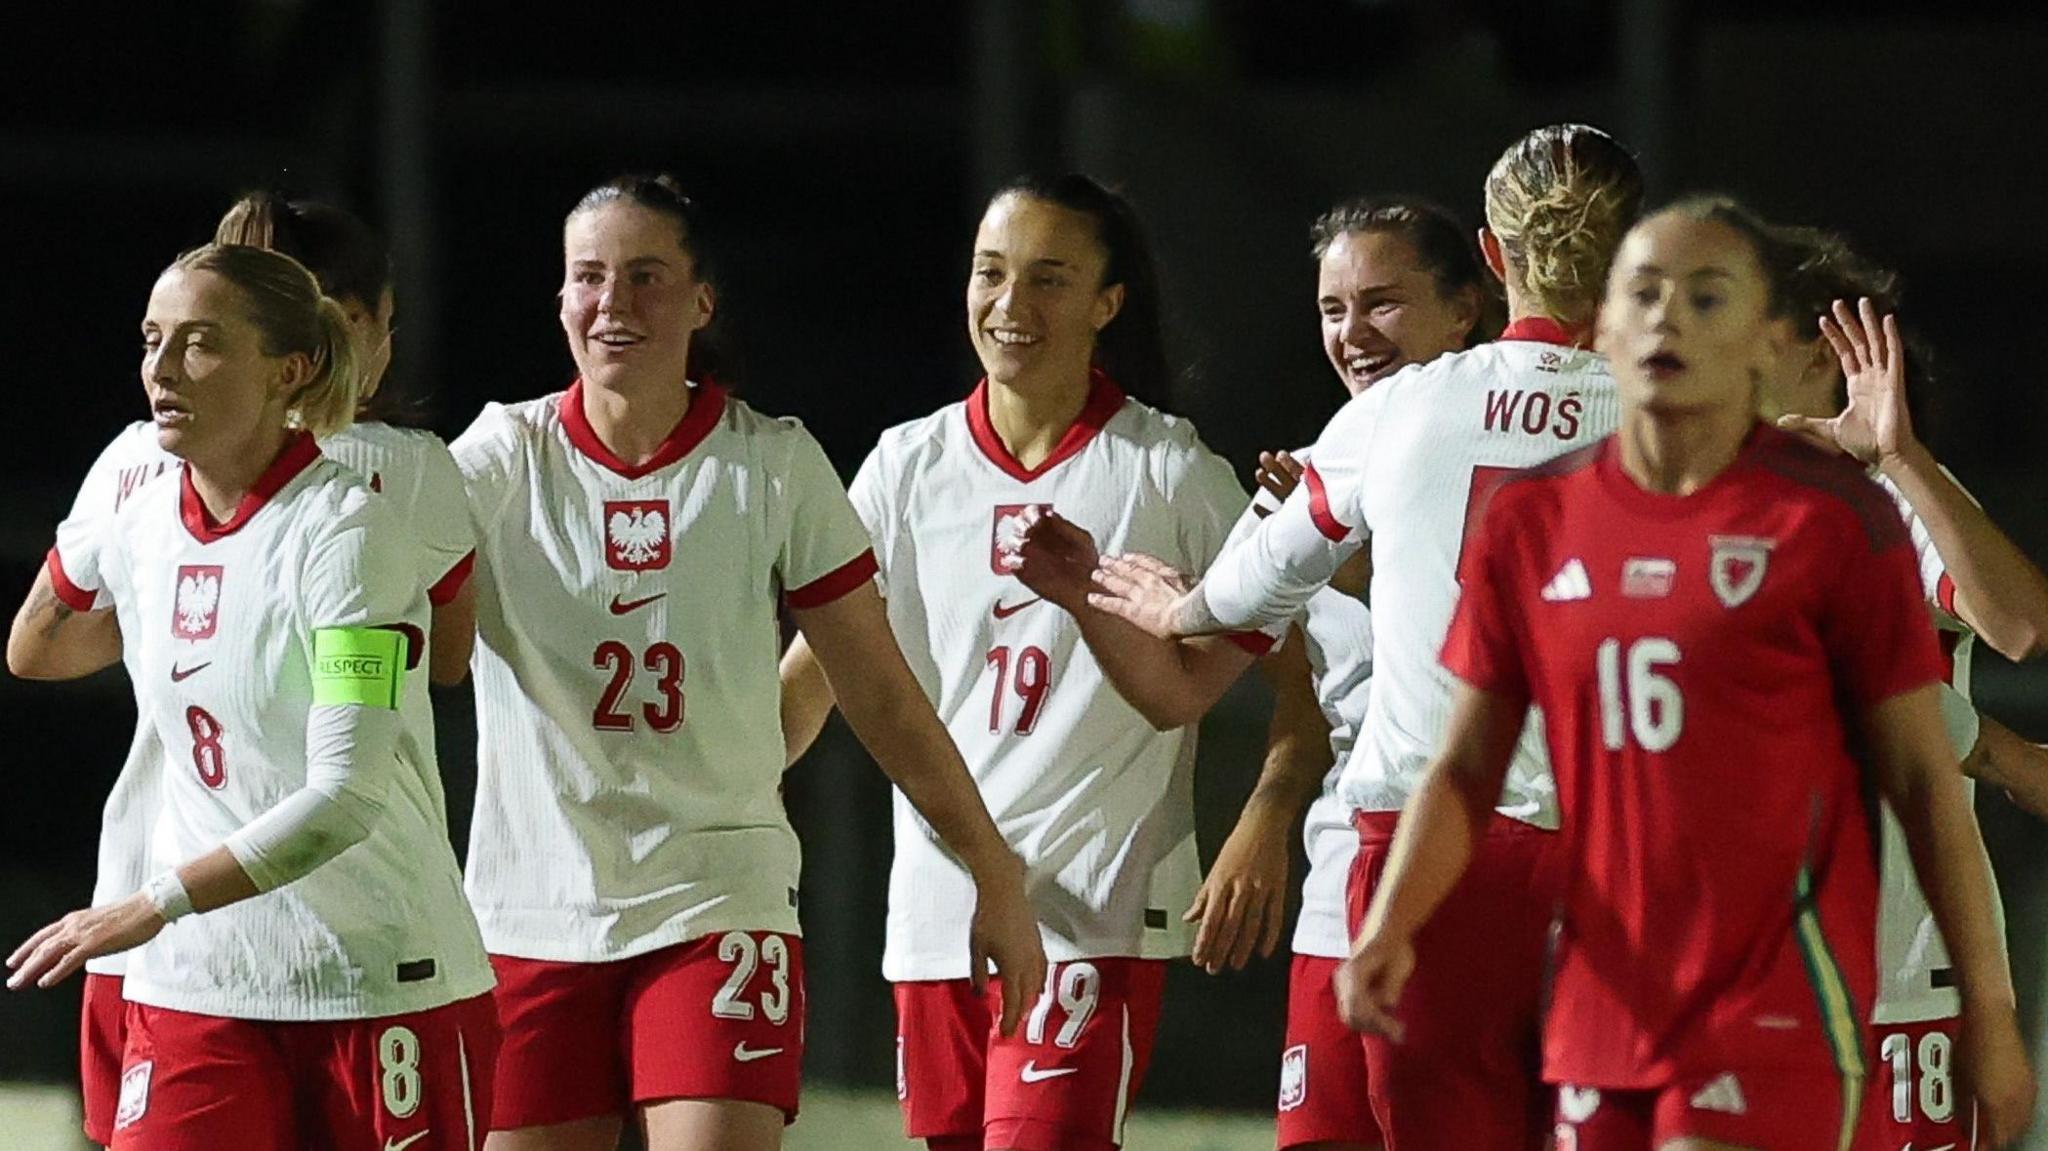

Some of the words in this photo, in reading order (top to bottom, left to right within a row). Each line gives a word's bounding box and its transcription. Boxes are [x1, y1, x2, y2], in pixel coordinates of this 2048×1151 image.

[1484, 390, 1582, 440] WOŚ
[320, 659, 383, 675] RESPECT
[592, 640, 685, 733] 23
[986, 646, 1052, 736] 19
[1597, 637, 1685, 753] 16
[186, 705, 227, 790] 8
[712, 931, 789, 1027] 23
[1026, 962, 1099, 1049] 19
[379, 1026, 421, 1119] 8
[1881, 1031, 1953, 1123] 18
